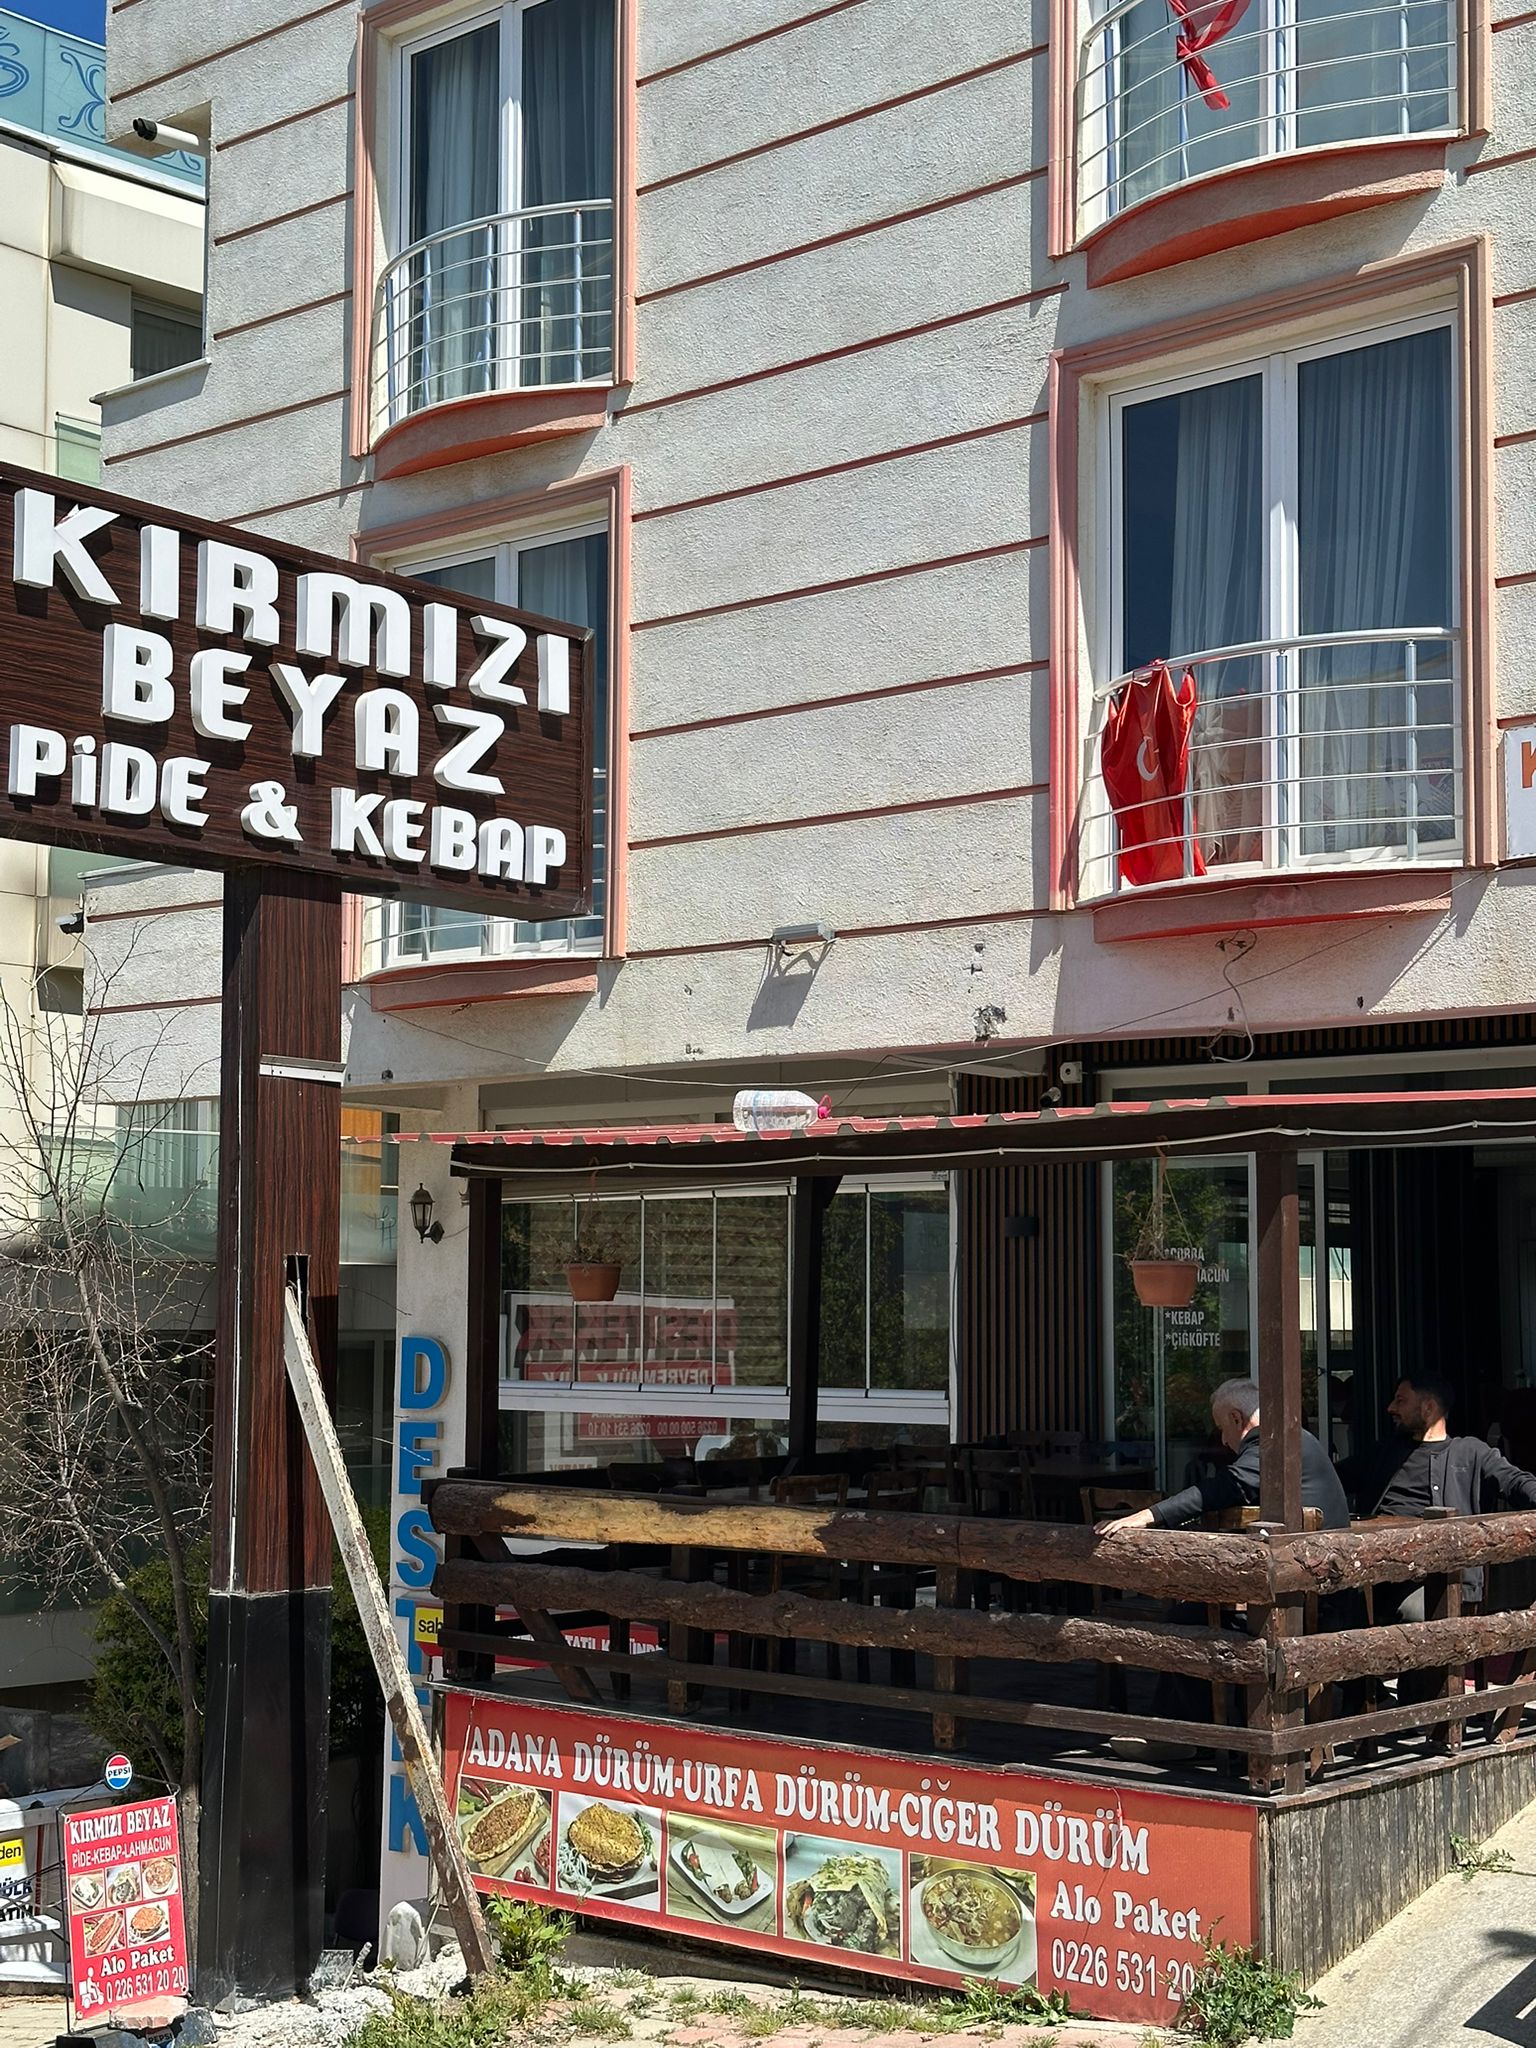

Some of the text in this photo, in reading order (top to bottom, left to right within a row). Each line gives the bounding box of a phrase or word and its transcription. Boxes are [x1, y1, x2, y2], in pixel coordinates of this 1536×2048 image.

[12, 487, 571, 715] KIRMIZI
[101, 622, 507, 795] BEYAZ
[240, 780, 304, 841] &
[330, 786, 568, 885] KEBAP
[107, 1766, 131, 1778] PEPSI
[467, 1726, 563, 1779] ADANA
[572, 1733, 764, 1814] DÜRÜM-URFA
[1014, 1800, 1150, 1876] DÜRÜM
[70, 1805, 171, 1845] KIRMIZI BEYAZ
[1050, 1880, 1202, 1942] Alo Paket
[101, 1945, 175, 1977] Alo Paket
[106, 1965, 185, 2003] 0 226 531 20 20
[1051, 1938, 1109, 1987] 0226
[1116, 1949, 1157, 1997] 531
